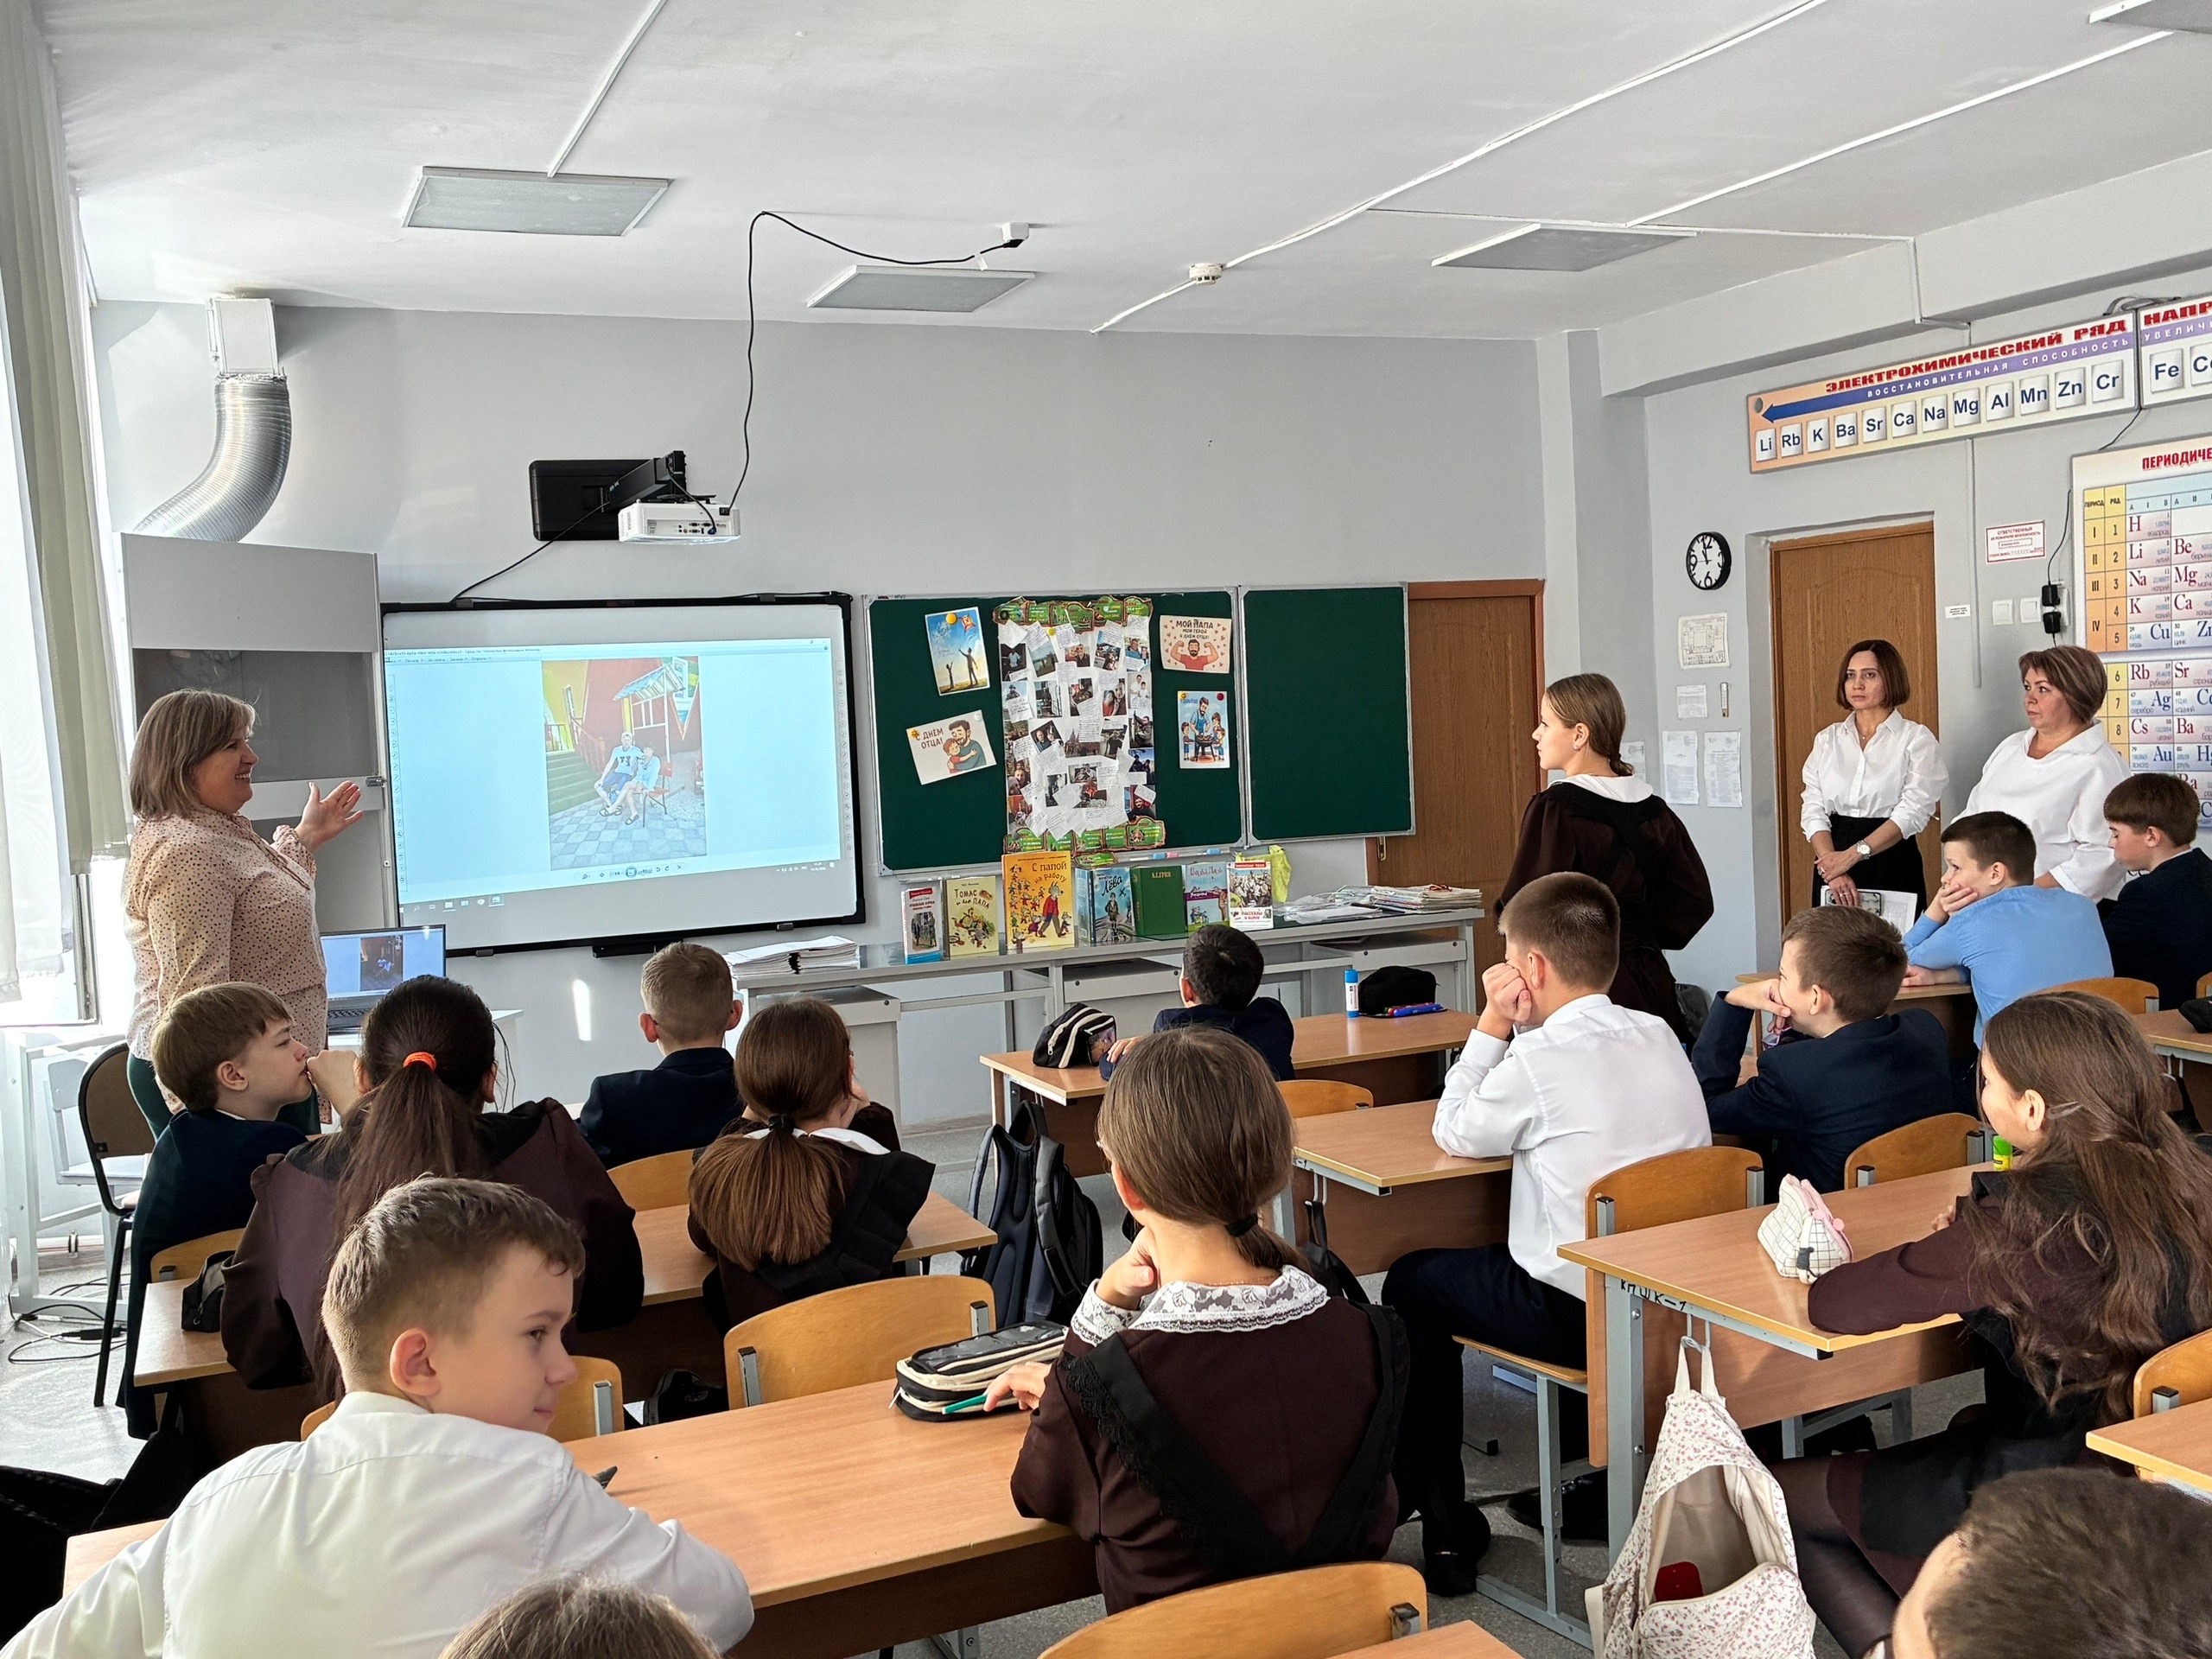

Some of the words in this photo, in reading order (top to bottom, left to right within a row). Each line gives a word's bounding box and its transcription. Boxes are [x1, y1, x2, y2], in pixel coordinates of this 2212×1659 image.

[1826, 332, 2063, 393] ЭЛЕКТРОХИМИЧЕСКИЙ
[2074, 320, 2127, 341] РЯД
[1867, 362, 2009, 398] ВОССТАНОВИТЕЛЬНАЯ
[2023, 338, 2129, 366] СПОСОБНОСТЬ
[2154, 363, 2180, 380] Fe
[2193, 356, 2212, 372] C
[1760, 437, 1772, 451] Li
[1782, 434, 1801, 448] Rb
[1813, 428, 1824, 442] K
[1836, 423, 1856, 437] Ba
[1866, 418, 1884, 432] Sr
[1893, 412, 1915, 427] Ca
[1923, 406, 1945, 421] Na
[1954, 398, 1979, 415] Mg
[1991, 392, 2009, 410] Al
[2020, 387, 2048, 404] Mn
[2057, 381, 2082, 397] Zn
[2096, 374, 2120, 390] Cr
[2113, 524, 2118, 536] 1
[2128, 515, 2142, 532] H
[2129, 543, 2143, 559] Li
[2174, 537, 2192, 555] Be
[1690, 554, 1698, 570] 9
[2113, 551, 2119, 563] 2
[1704, 571, 1713, 588] 6
[2113, 578, 2119, 590] 3
[2129, 570, 2147, 587] Na
[2174, 566, 2197, 587] Mg
[2129, 597, 2142, 614] K
[2174, 594, 2193, 610] Ca
[2113, 606, 2120, 617] 4
[1175, 620, 1192, 628] МОЙ
[2092, 620, 2101, 632] IV
[2150, 623, 2170, 639] Cu
[2114, 632, 2120, 644] 5
[2114, 671, 2120, 682] 6
[2131, 664, 2150, 680] Rb
[2174, 662, 2190, 678] Sr
[2115, 698, 2120, 709] 7
[2152, 690, 2171, 711] Ag
[2116, 724, 2121, 735] 8
[2131, 718, 2149, 734] Cs
[2177, 717, 2194, 734] Ba
[921, 737, 944, 749] ОТЦА!
[2152, 746, 2172, 761] Au
[1032, 862, 1038, 872] С
[1039, 861, 1067, 872] папой
[1044, 872, 1067, 883] работу
[972, 898, 990, 910] ПАПА
